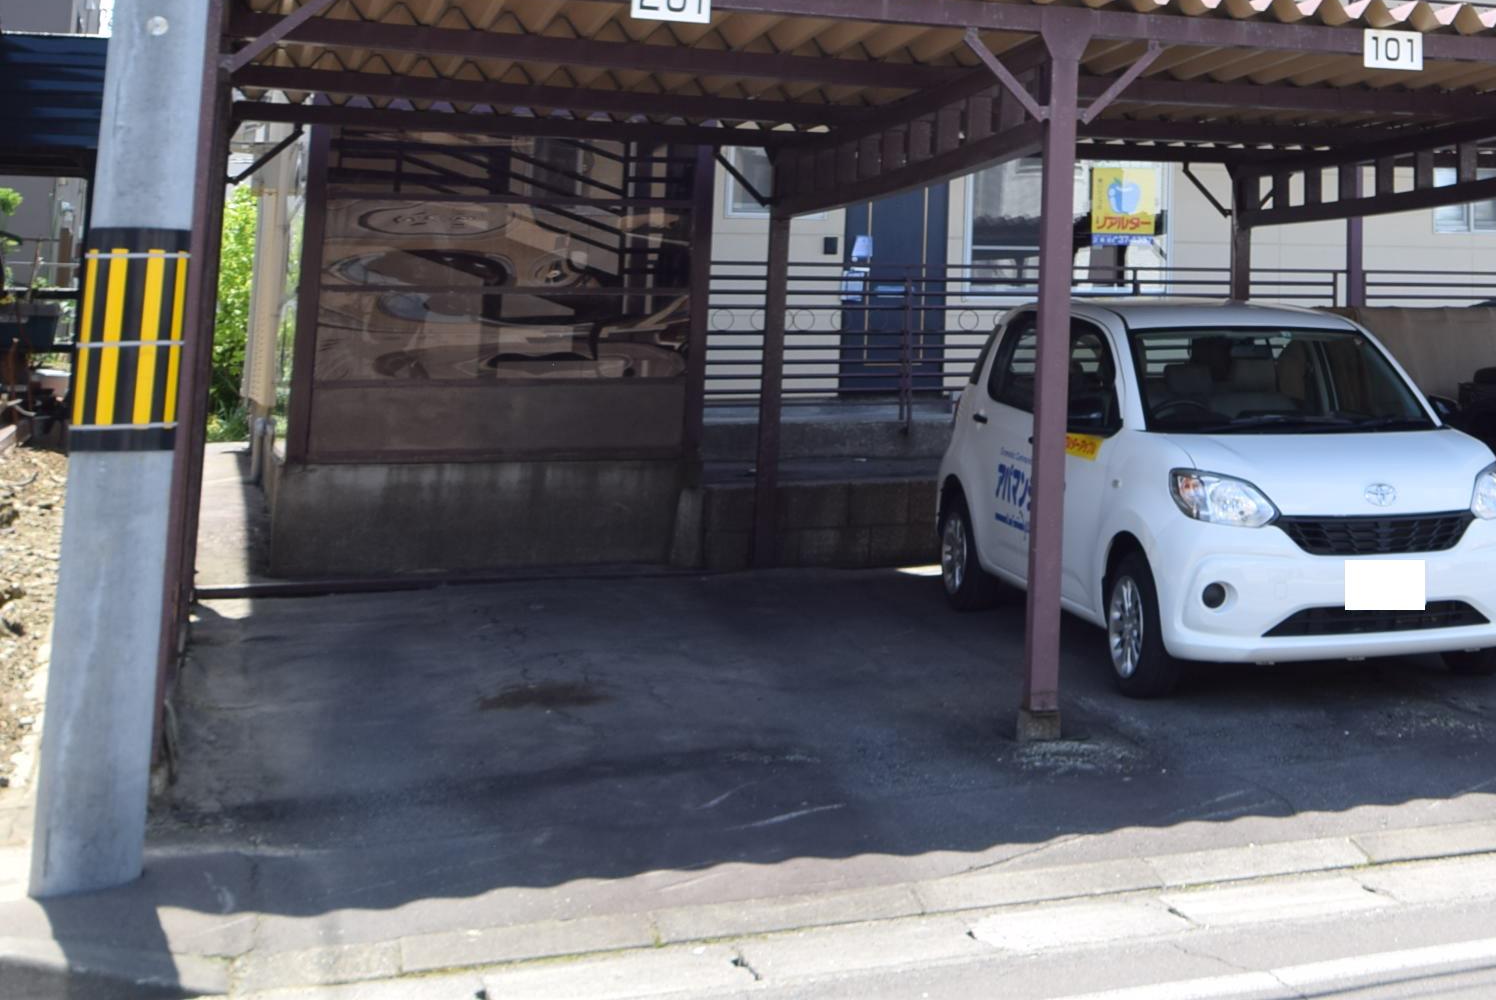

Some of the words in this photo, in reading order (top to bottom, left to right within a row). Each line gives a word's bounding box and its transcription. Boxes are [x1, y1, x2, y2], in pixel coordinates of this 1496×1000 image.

[1371, 36, 1414, 63] 101
[1096, 216, 1152, 230] リアルター
[995, 463, 1033, 511] アパマン
